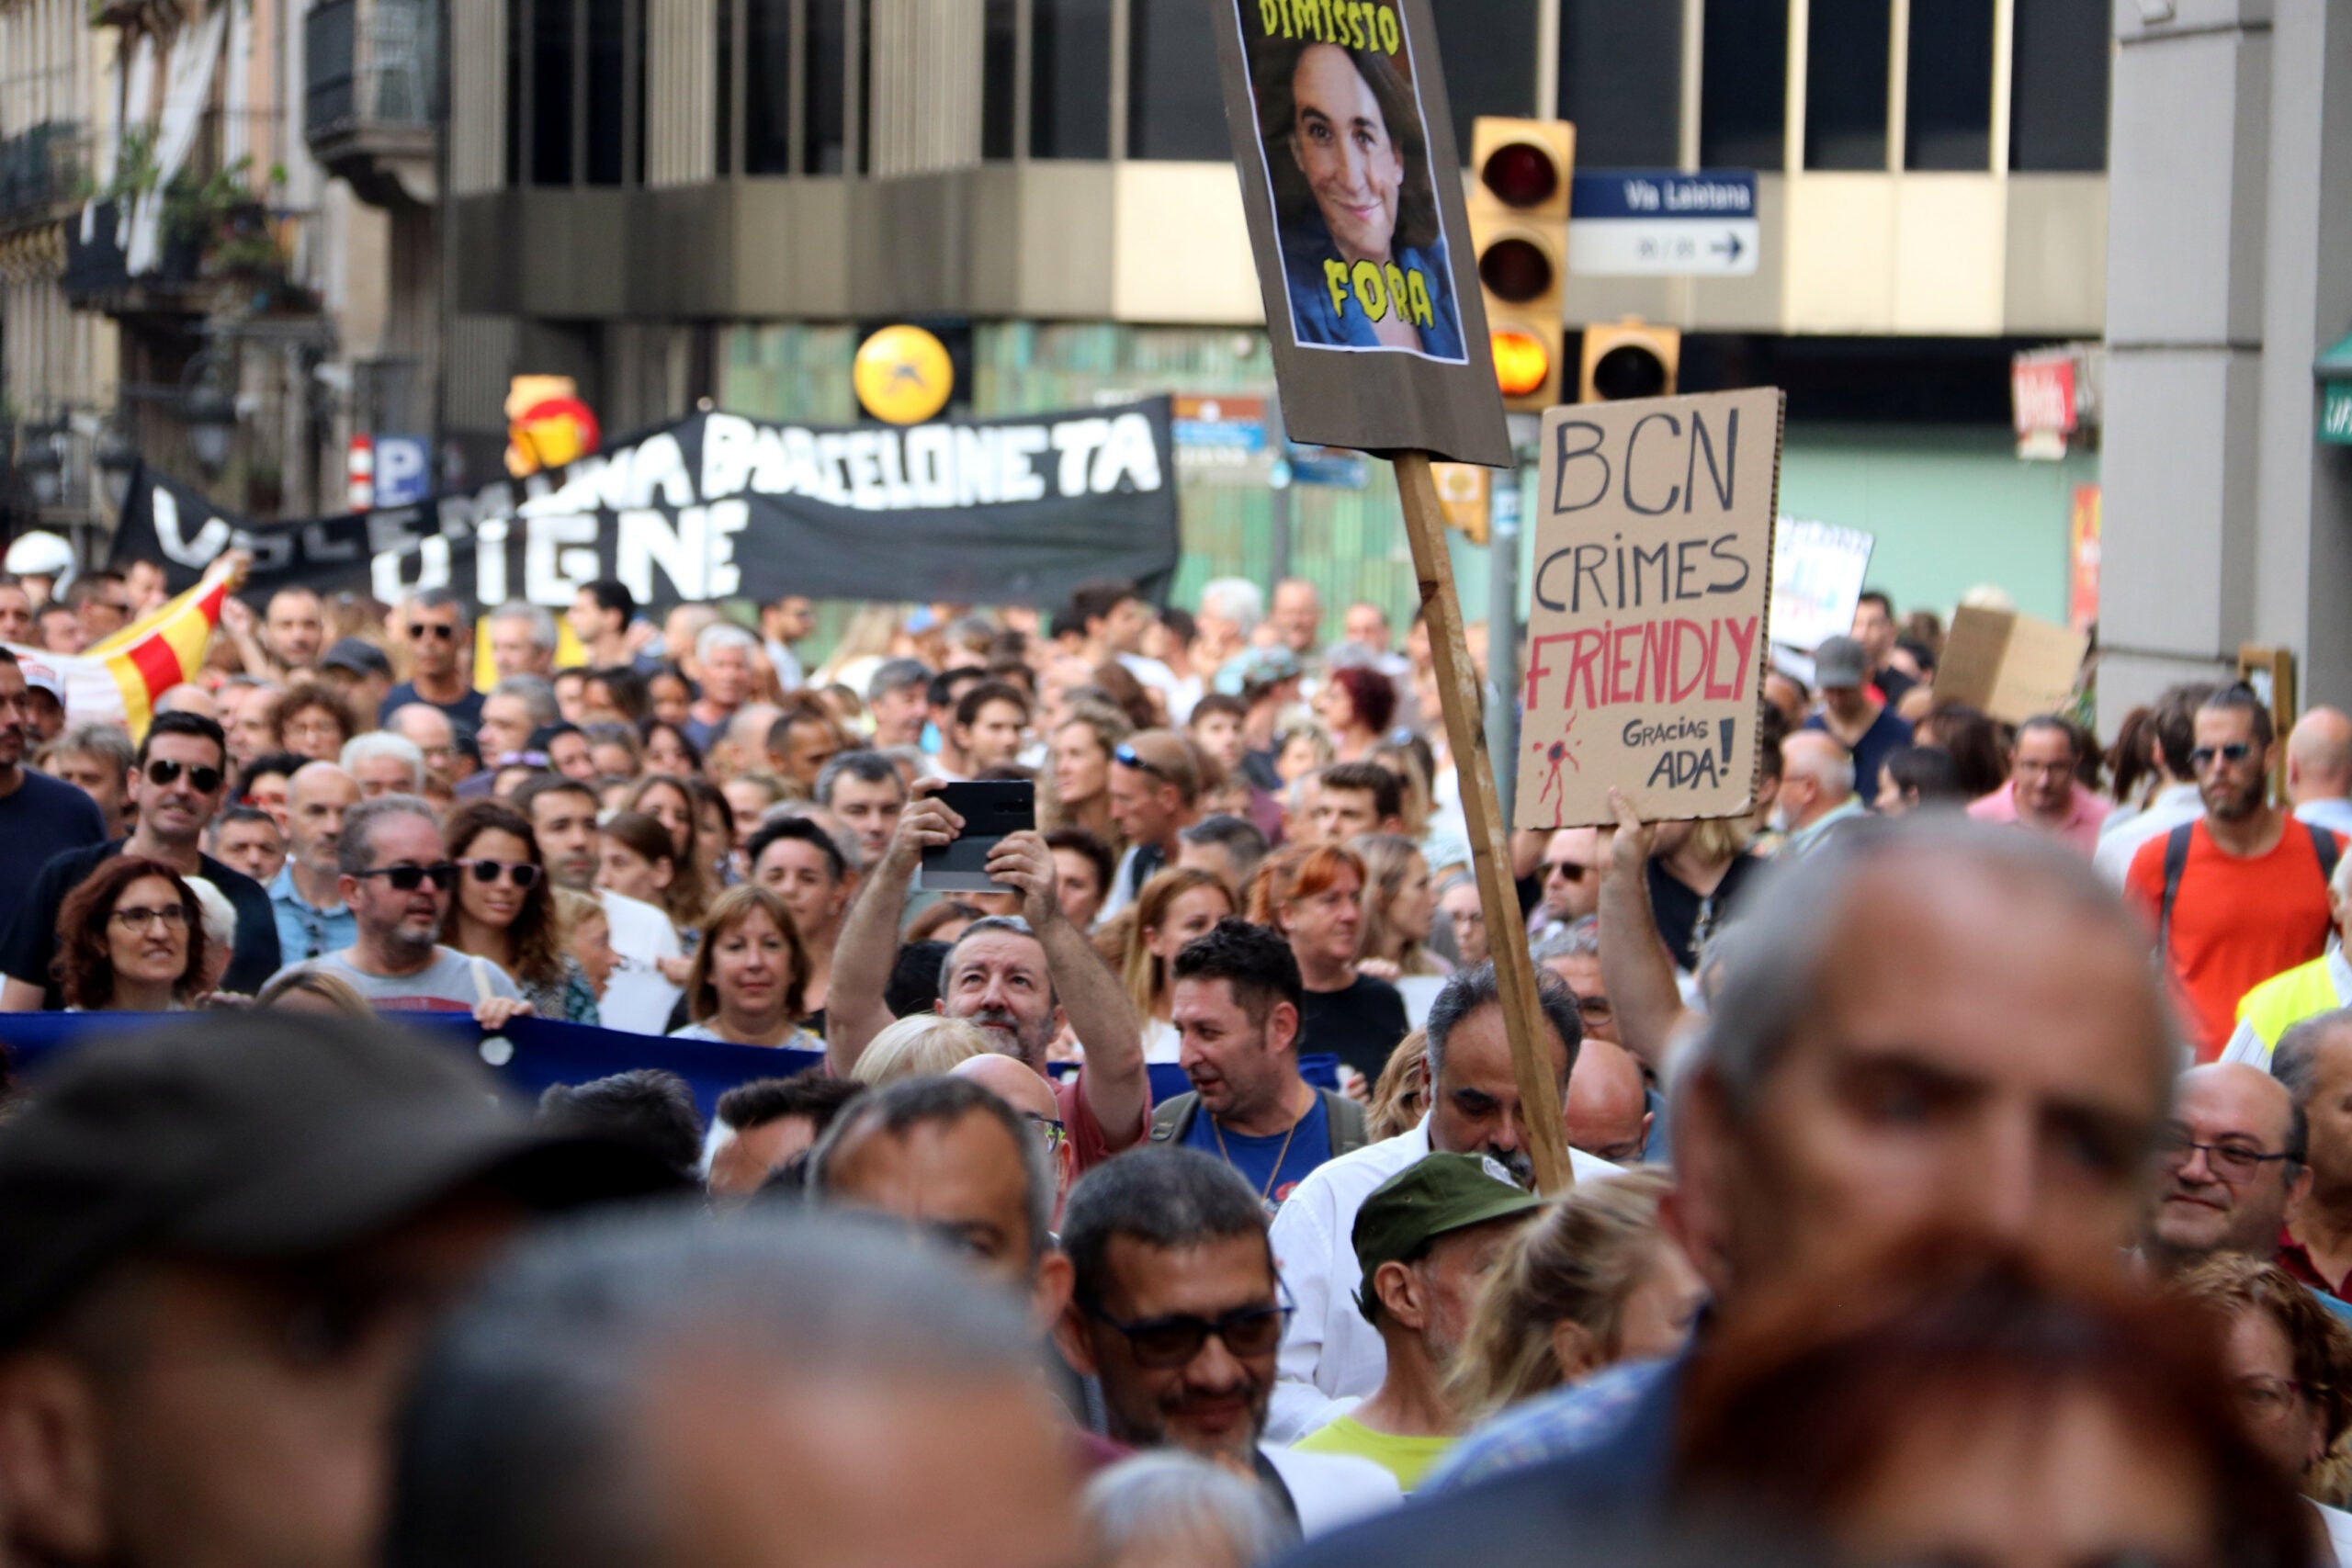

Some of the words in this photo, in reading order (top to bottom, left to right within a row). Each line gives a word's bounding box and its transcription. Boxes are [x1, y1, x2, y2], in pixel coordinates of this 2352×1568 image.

[1259, 0, 1399, 55] DIMISSIO
[1623, 179, 1660, 210] Via
[1663, 179, 1750, 210] Laietana
[1323, 258, 1434, 329] FORA
[377, 438, 424, 491] P
[702, 411, 1162, 511] BARCELONETA
[1553, 408, 1739, 516] BCN
[1647, 718, 1736, 790] ADA!
